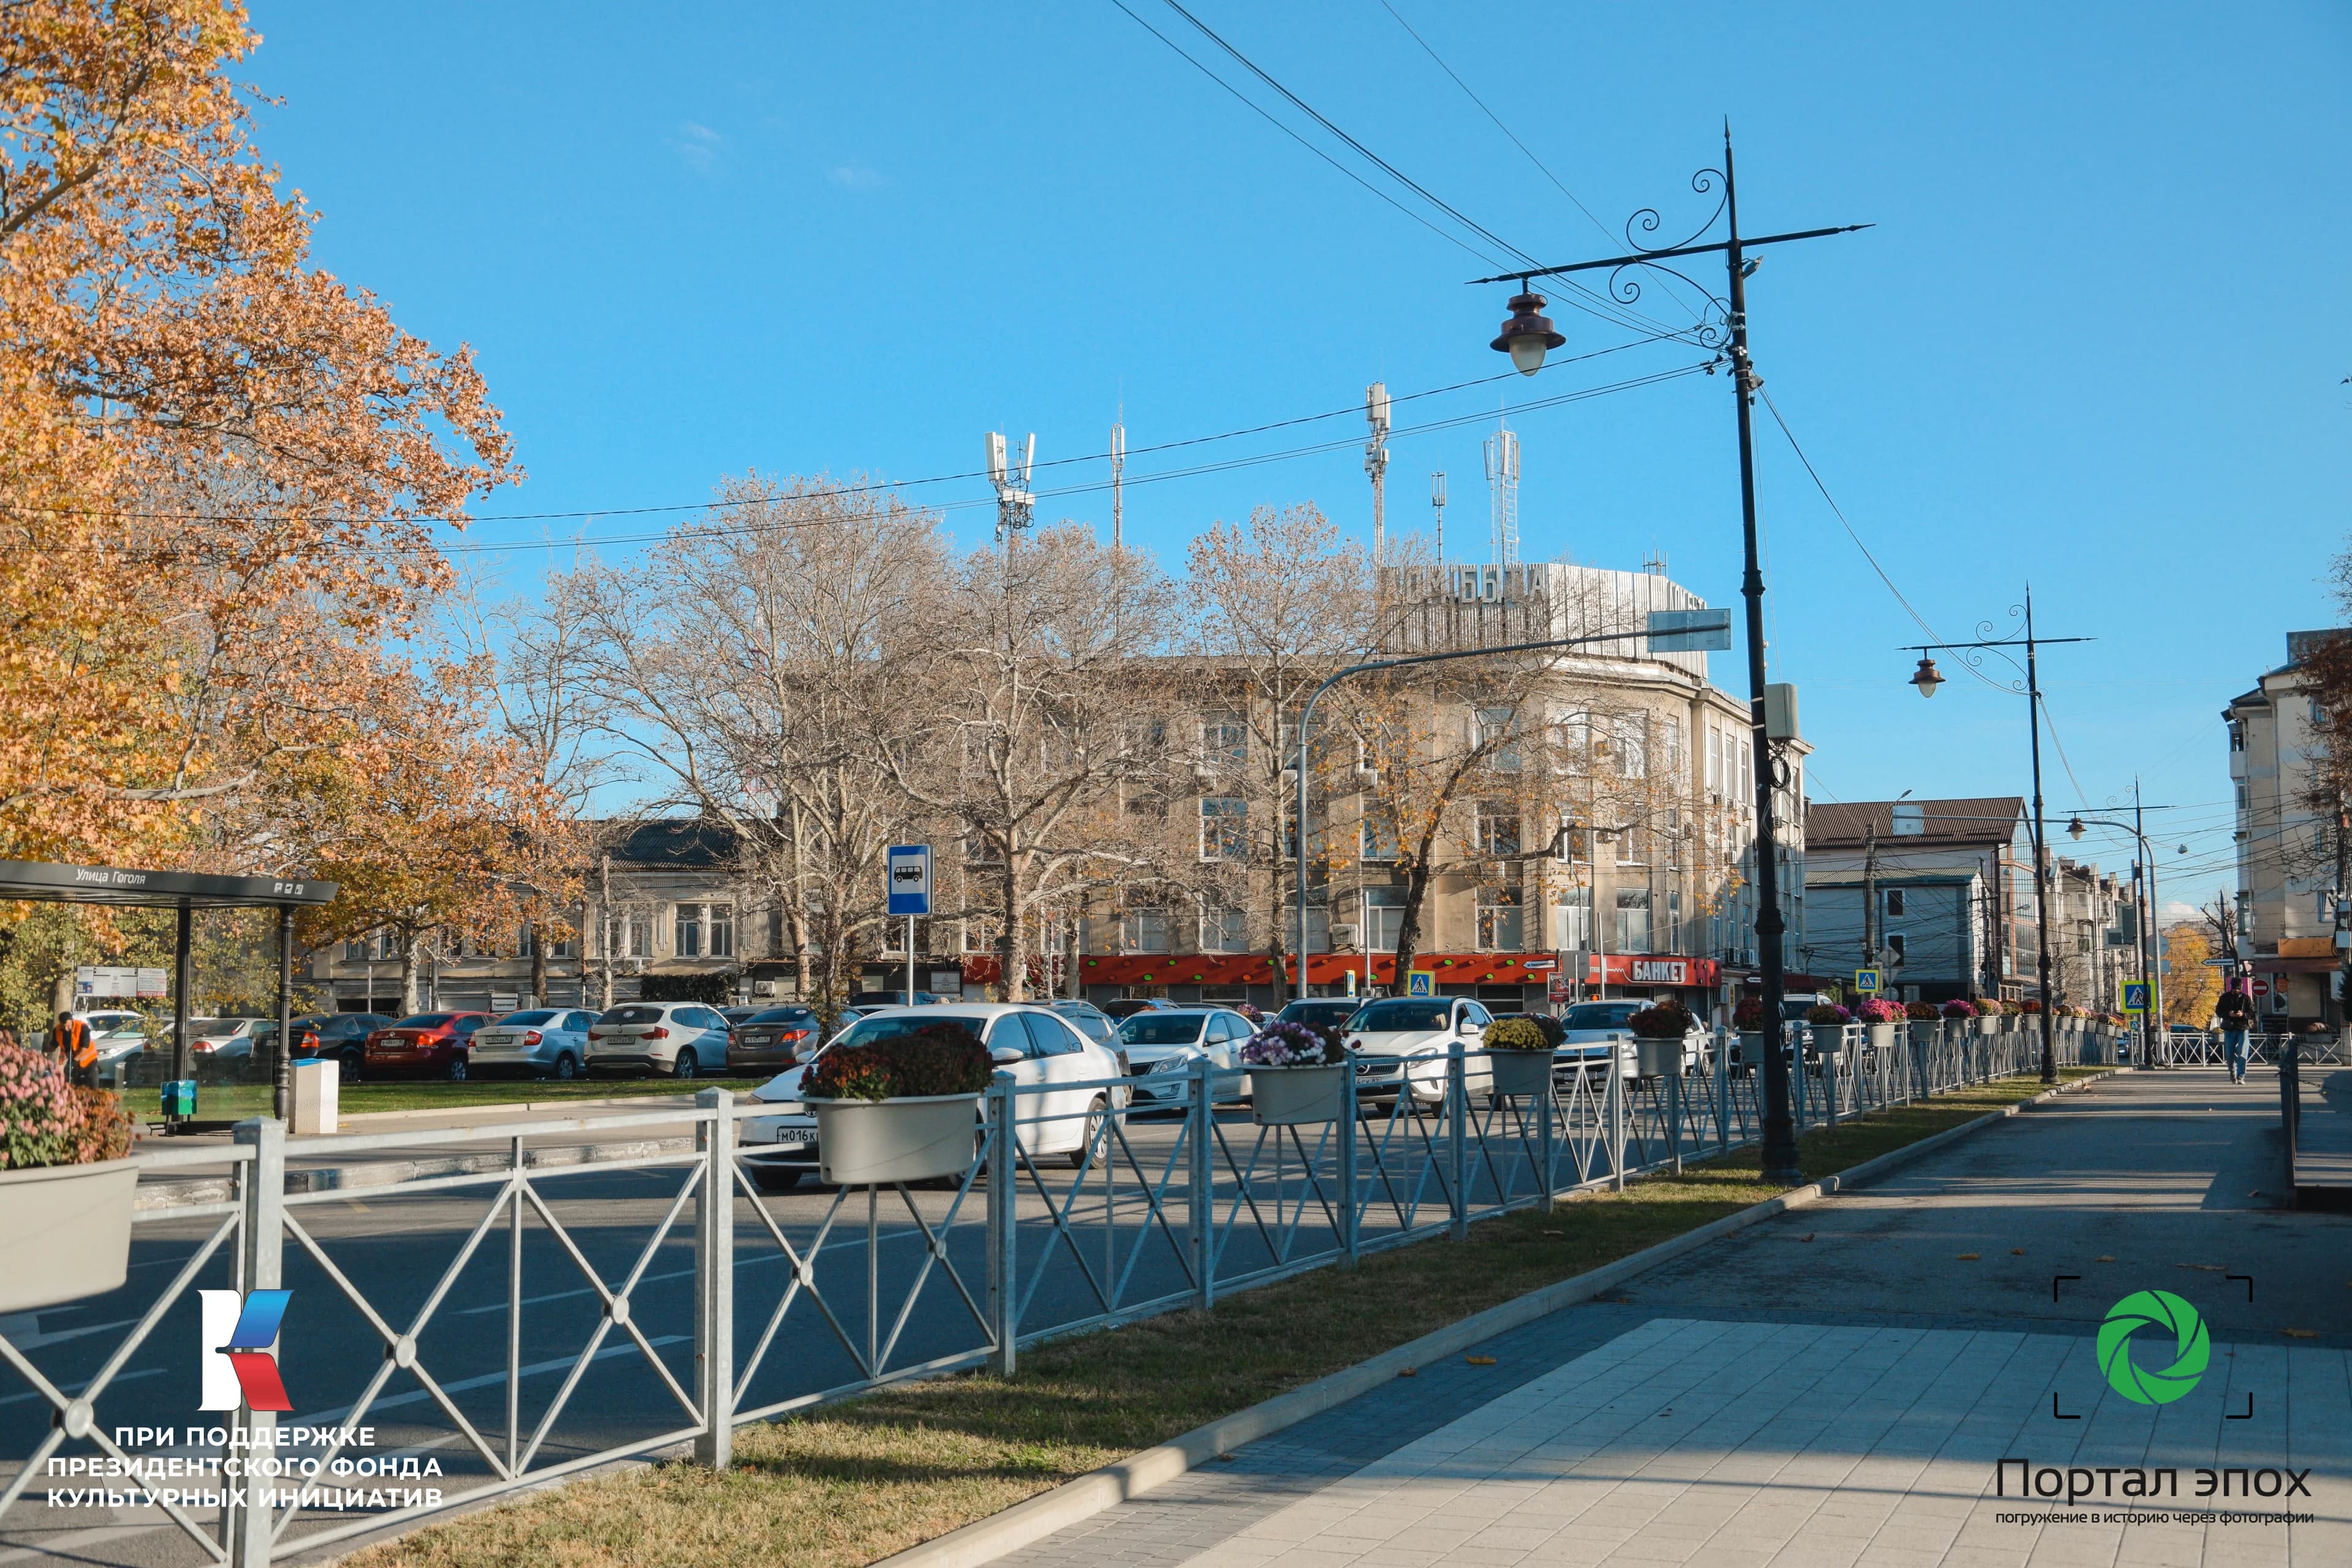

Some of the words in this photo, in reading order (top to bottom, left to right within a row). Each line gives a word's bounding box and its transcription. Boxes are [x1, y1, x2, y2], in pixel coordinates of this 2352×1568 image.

[75, 869, 108, 884] Улица
[113, 871, 146, 884] Гоголя
[1632, 960, 1686, 981] БАНКЕТ
[782, 1130, 818, 1141] М016К
